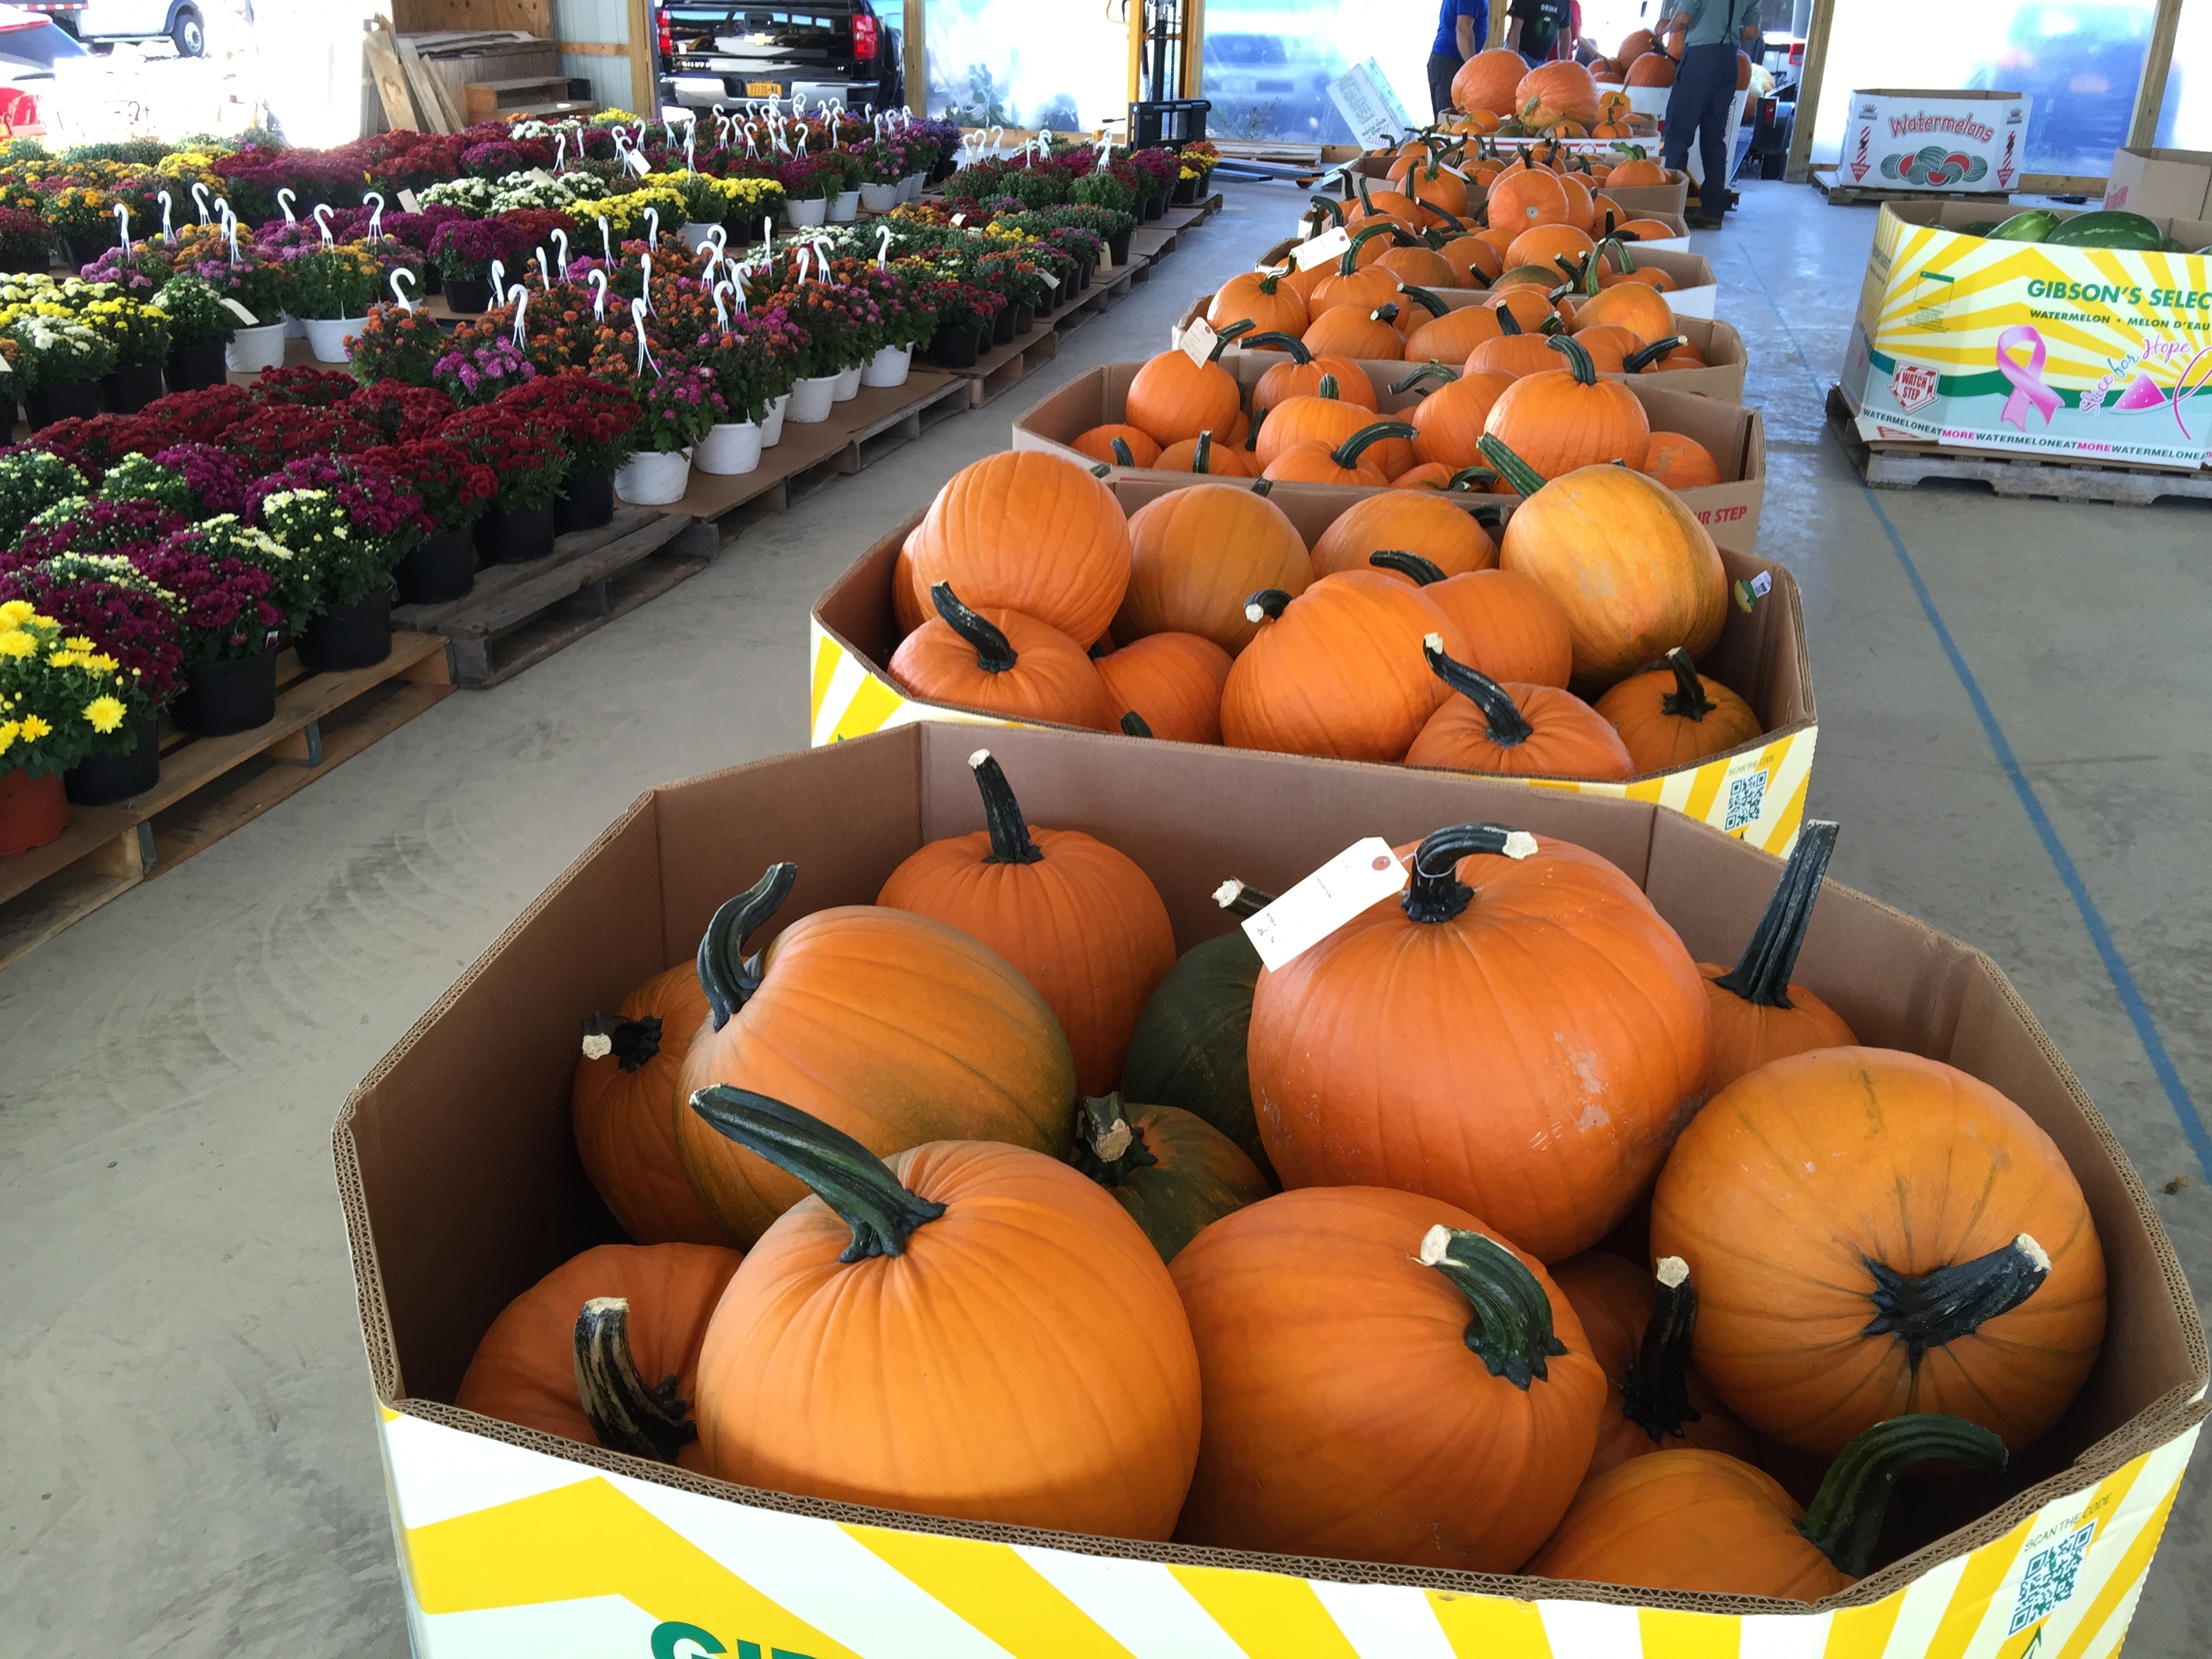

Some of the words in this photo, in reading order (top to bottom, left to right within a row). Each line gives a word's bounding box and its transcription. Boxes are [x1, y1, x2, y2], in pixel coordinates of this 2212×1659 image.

[1540, 3, 1559, 14] DRINK
[1888, 110, 1995, 144] Watermelons
[2027, 279, 2142, 305] GIBSON'S
[2148, 287, 2212, 310] SELEC
[2029, 308, 2112, 324] WATERMELON
[2127, 316, 2170, 329] MELON
[2173, 319, 2211, 331] D'EAU
[1901, 371, 1928, 389] WATCH
[2079, 374, 2114, 416] Slice
[2107, 353, 2140, 380] for
[2142, 333, 2192, 364] Hope
[1902, 386, 1921, 402] STEP
[1714, 505, 1748, 524] STEP
[2024, 1524, 2058, 1553] SCAN
[2060, 1512, 2083, 1532] THE
[2082, 1492, 2113, 1519] CODE
